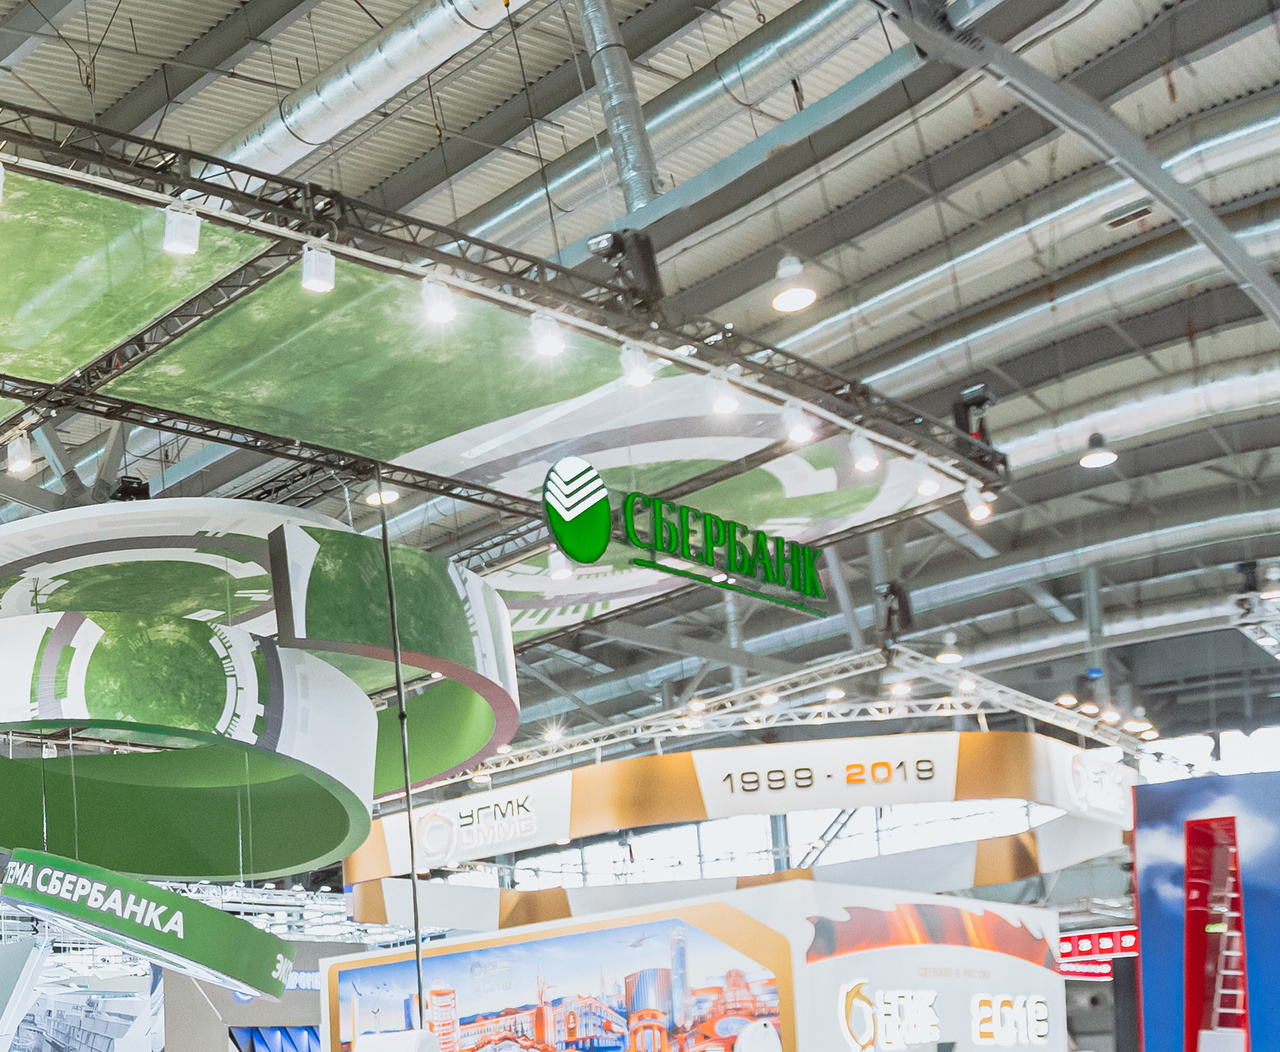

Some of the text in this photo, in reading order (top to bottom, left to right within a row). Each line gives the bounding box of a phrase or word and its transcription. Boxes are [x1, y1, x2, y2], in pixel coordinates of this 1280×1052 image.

[623, 491, 825, 599] СБЕРБАНК
[722, 767, 814, 794] 1999
[846, 759, 935, 784] 2019
[459, 795, 531, 828] УГМК
[36, 867, 184, 939] СБЕРБАНКА
